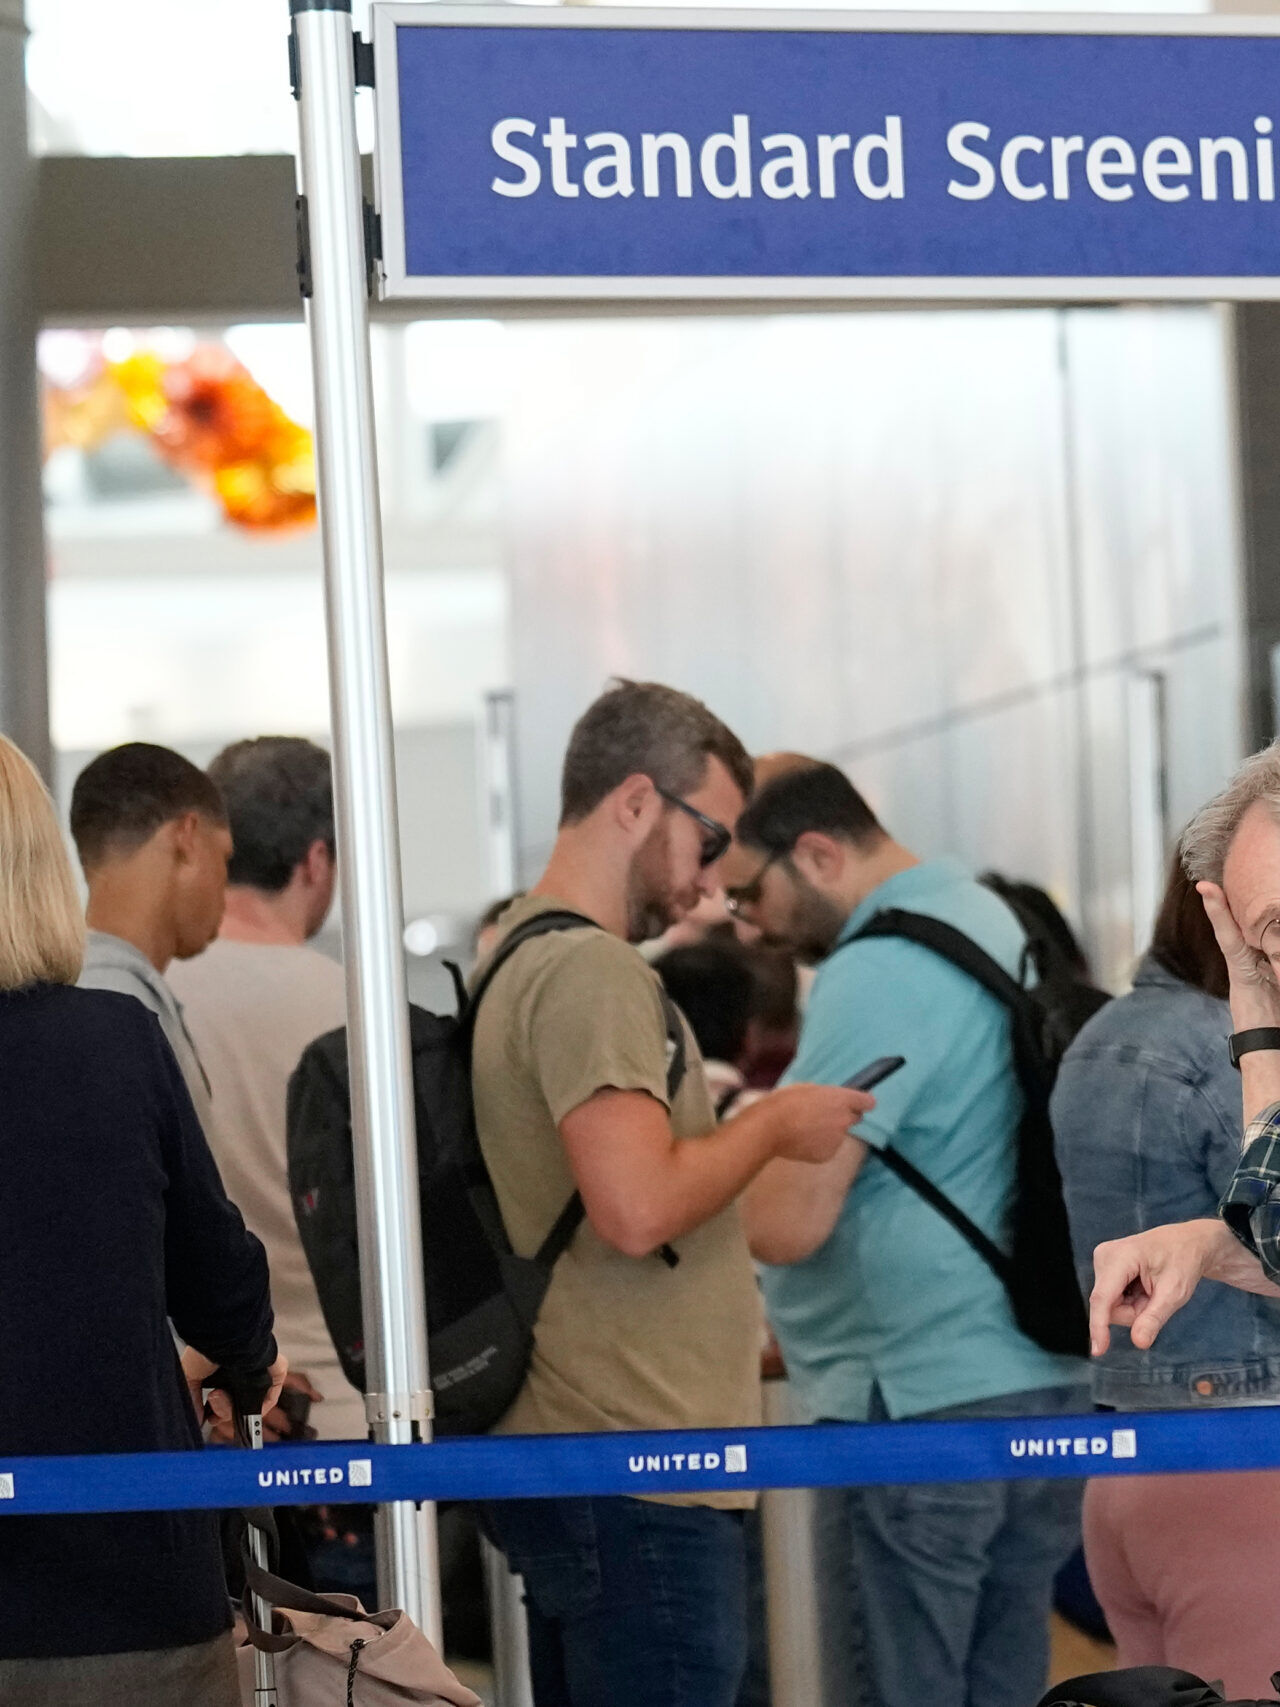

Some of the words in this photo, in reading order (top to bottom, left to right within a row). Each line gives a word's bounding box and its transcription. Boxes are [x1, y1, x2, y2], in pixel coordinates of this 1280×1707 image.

[490, 114, 905, 200] Standard
[1010, 1438, 1108, 1457] UNITED
[628, 1453, 720, 1472] UNITED
[258, 1467, 344, 1487] UNITED
